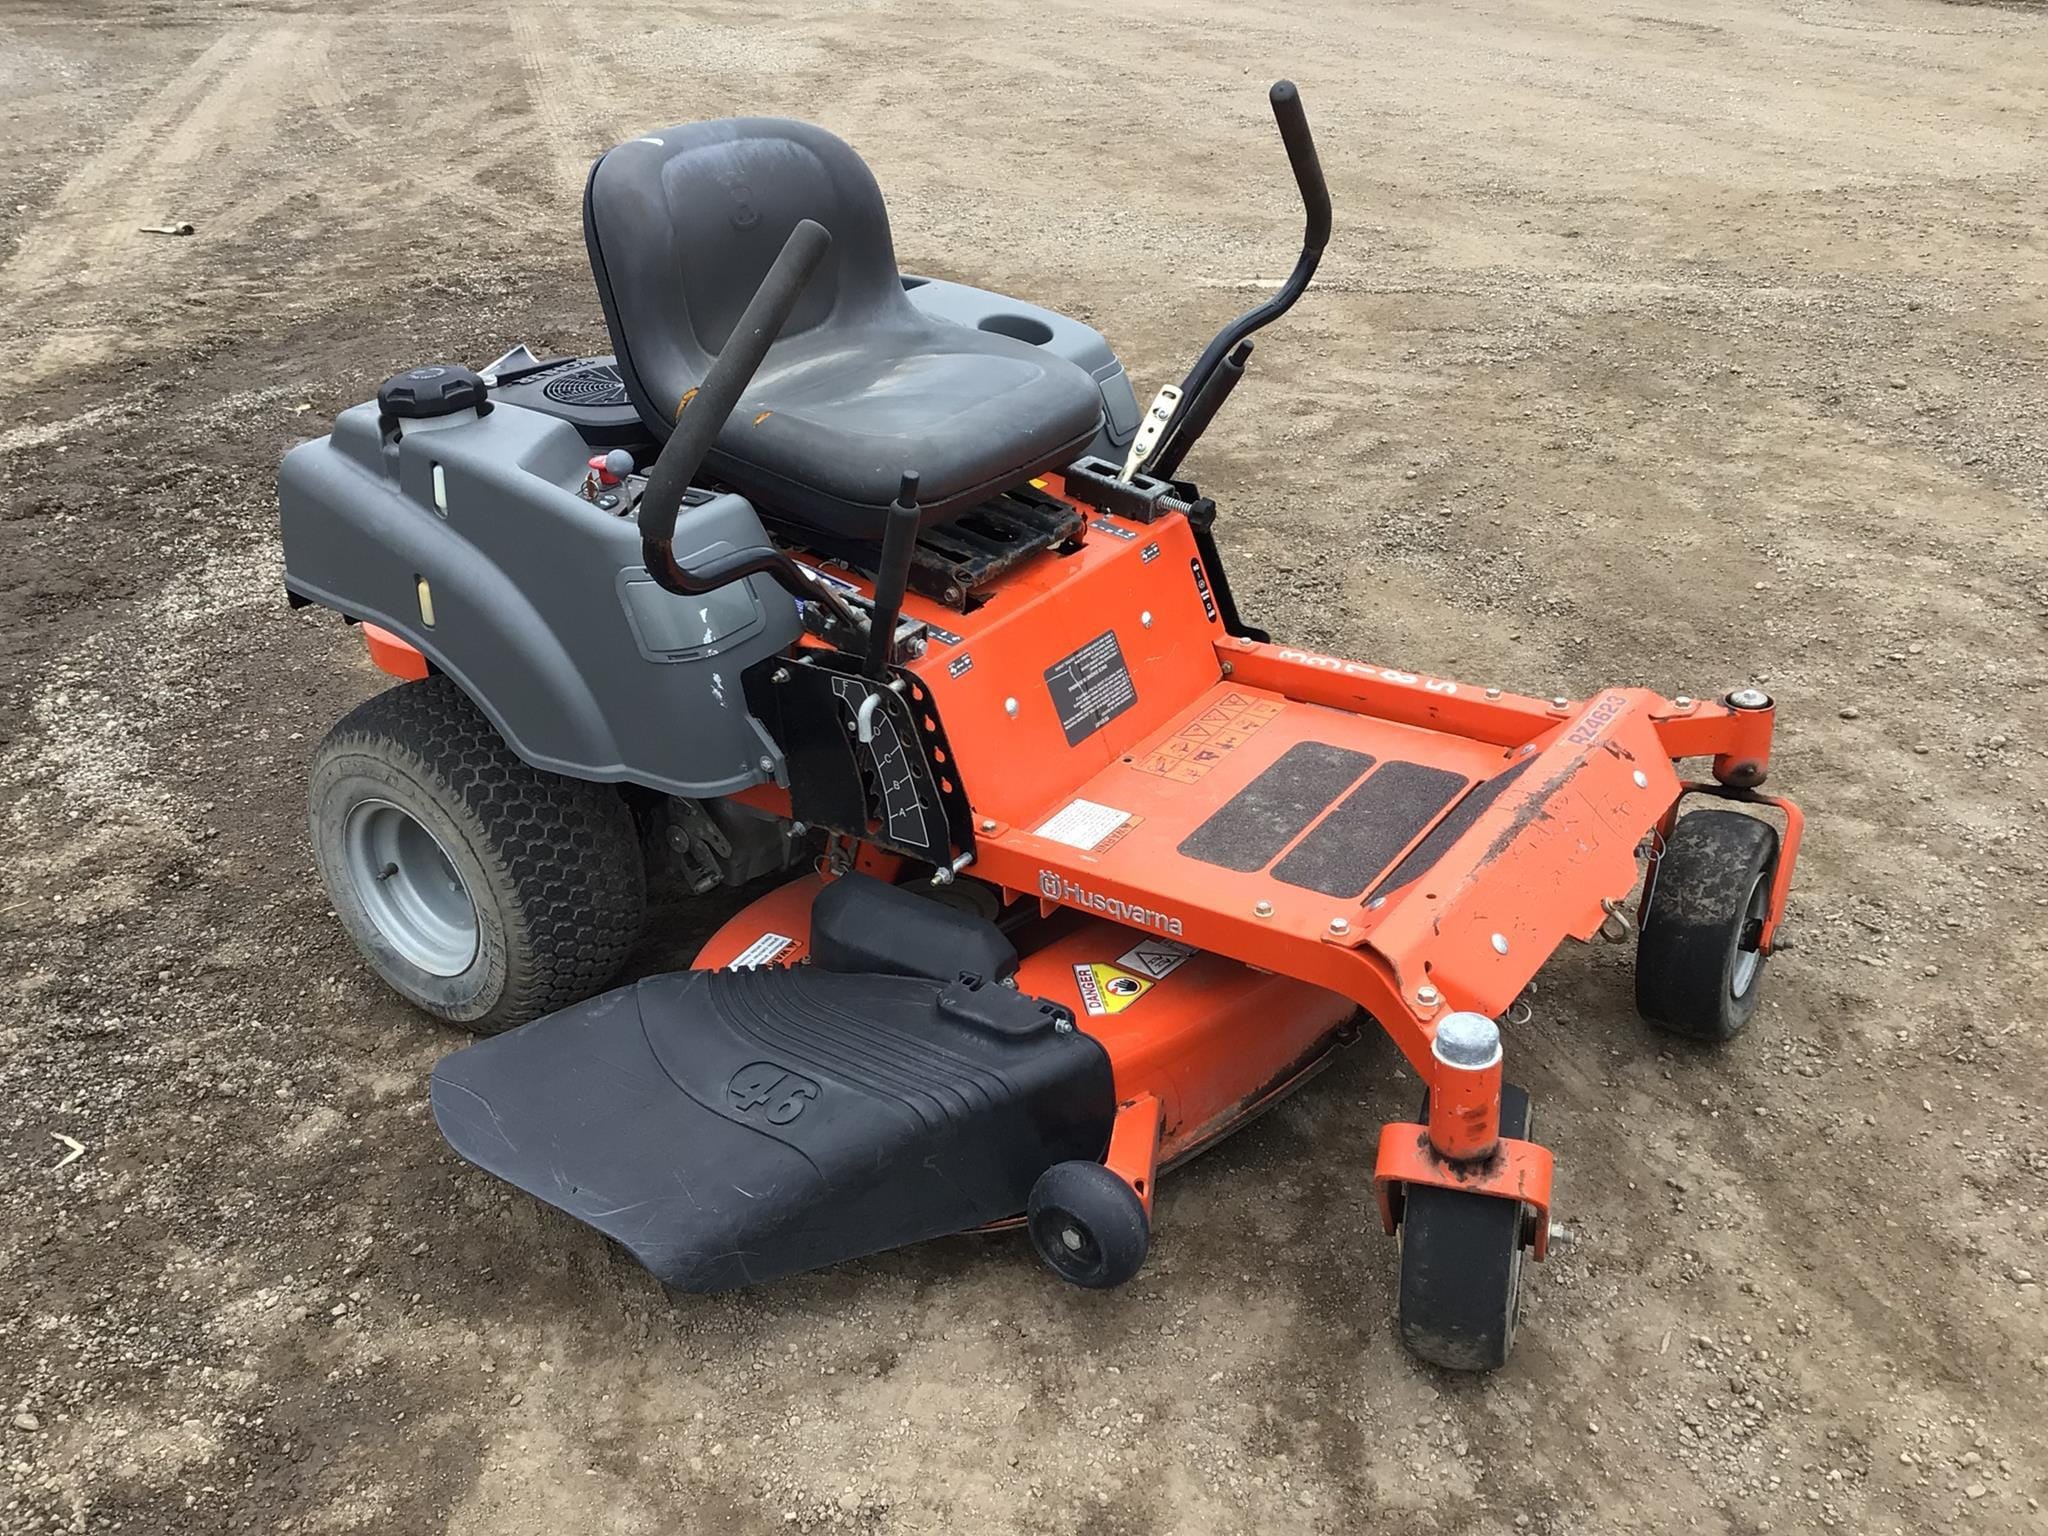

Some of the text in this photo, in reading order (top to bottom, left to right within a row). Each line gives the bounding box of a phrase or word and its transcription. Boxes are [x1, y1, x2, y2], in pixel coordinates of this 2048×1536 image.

[1568, 695, 1626, 744] RZ4623
[884, 753, 893, 763] C
[893, 780, 901, 790] B
[898, 808, 907, 818] A
[1063, 879, 1184, 936] Husqvarna
[1078, 969, 1102, 1009] DANGER
[729, 1072, 819, 1126] 46
